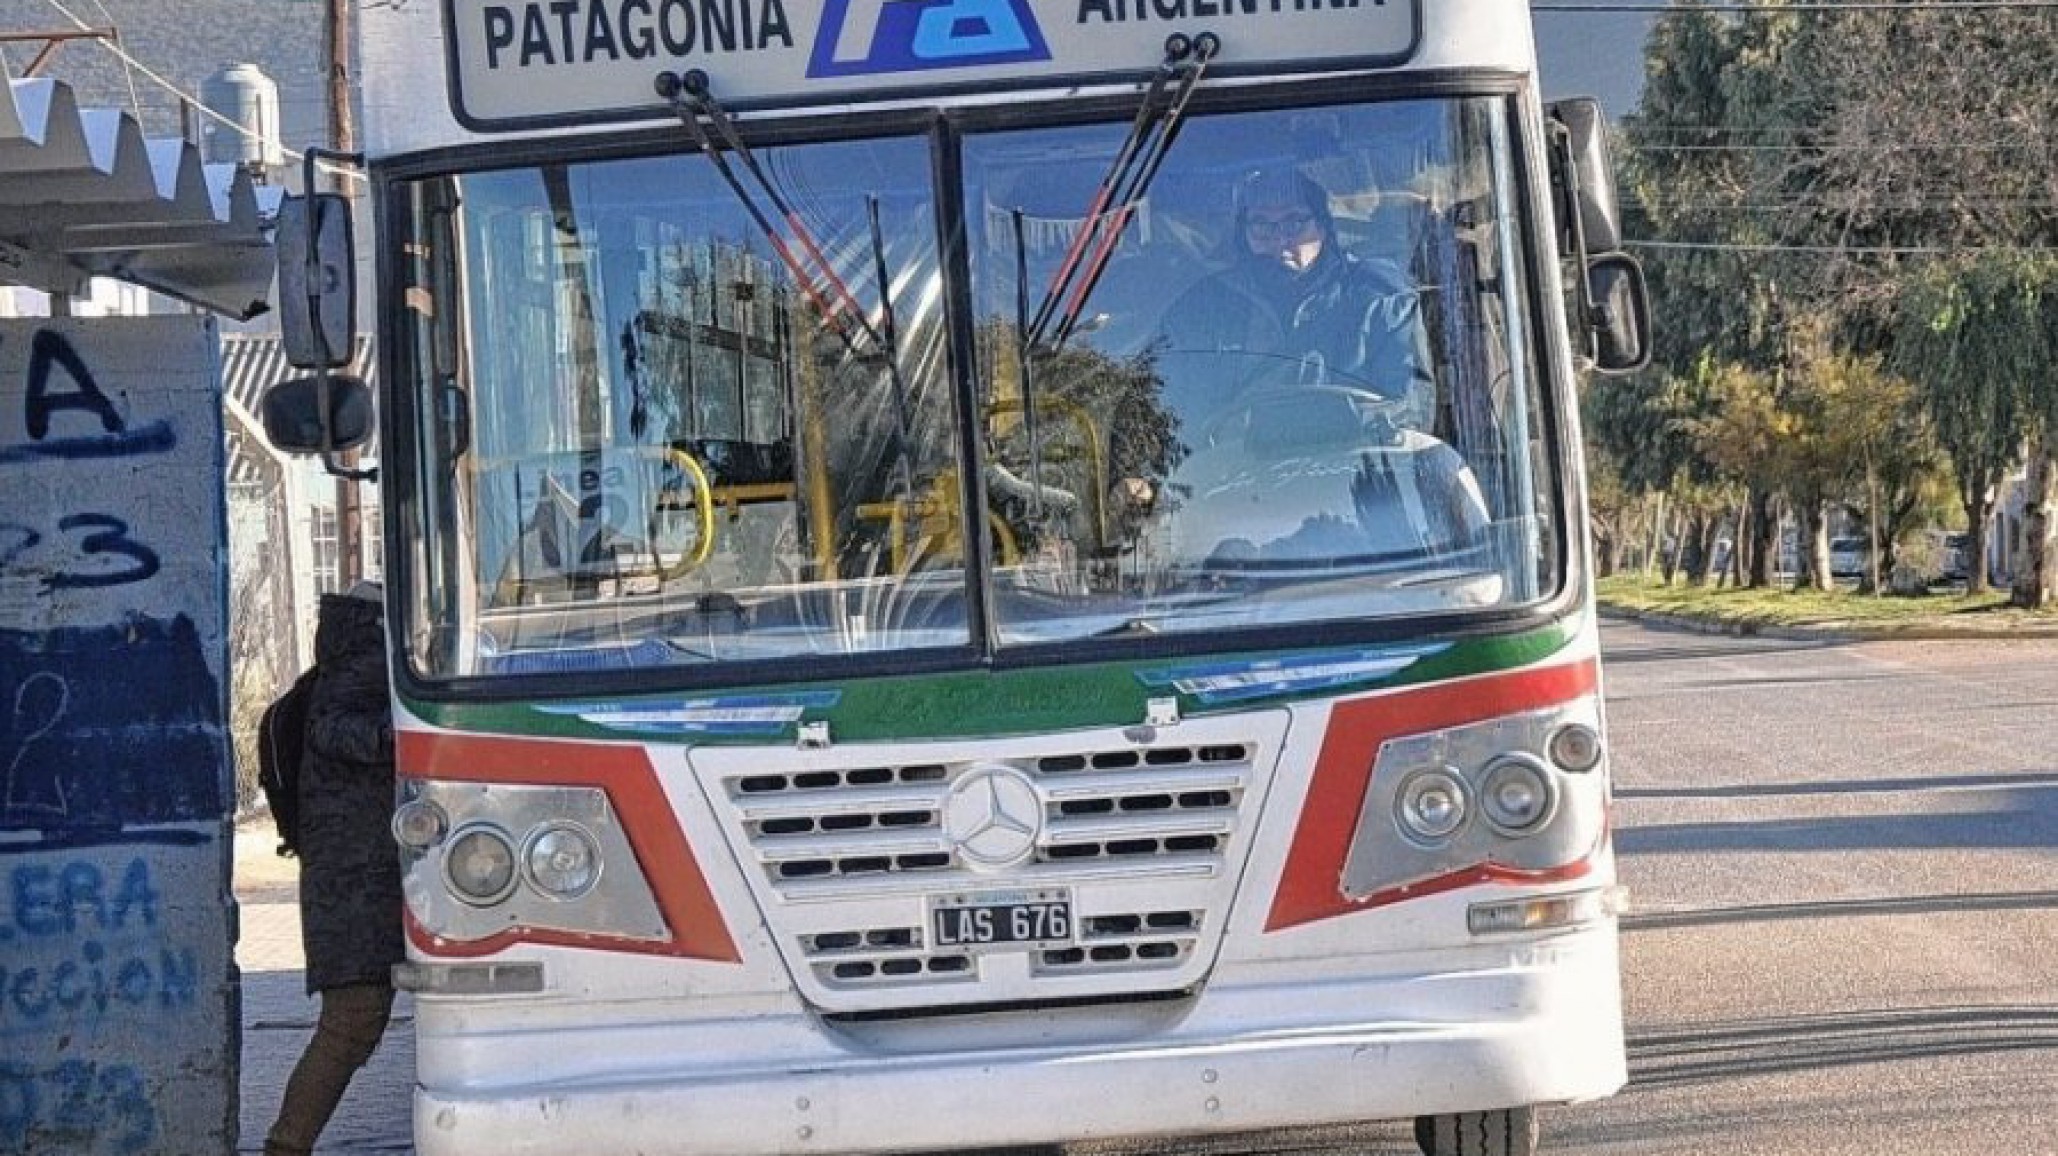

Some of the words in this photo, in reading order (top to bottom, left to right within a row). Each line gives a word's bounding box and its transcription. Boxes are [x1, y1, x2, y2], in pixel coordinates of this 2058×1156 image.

[484, 0, 795, 69] PATAGONIA
[0, 328, 126, 440] A
[0, 857, 162, 940] ERA
[939, 909, 994, 943] LAS
[1012, 904, 1067, 939] 676
